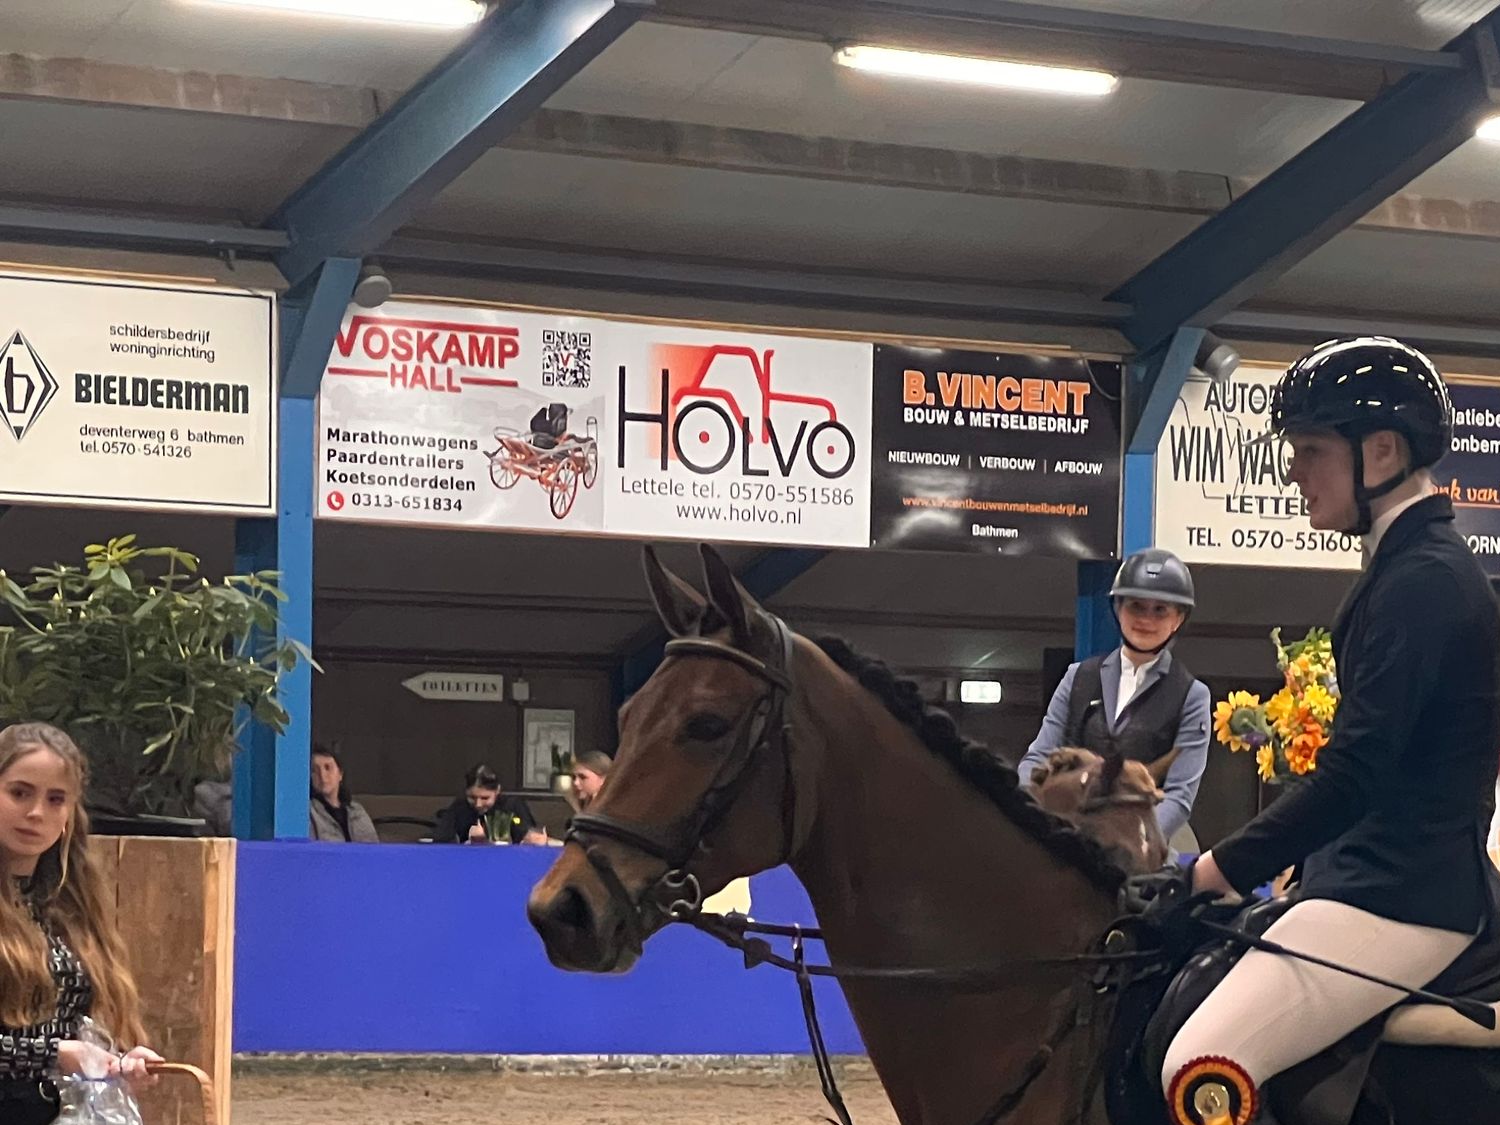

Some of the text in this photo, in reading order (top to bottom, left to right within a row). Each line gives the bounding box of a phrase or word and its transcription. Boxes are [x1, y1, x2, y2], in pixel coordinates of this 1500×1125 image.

[109, 324, 211, 343] schildersbedrijf
[336, 315, 520, 369] VOSKAMP
[109, 342, 215, 363] woninginrichting
[390, 363, 462, 393] HALL
[74, 373, 249, 414] BIELDERMAN
[903, 407, 1089, 434] BOUW & METSELBEDRIJF
[79, 424, 245, 445] deventerweg 6 bathmen
[326, 427, 479, 451] Marathonwagens
[80, 441, 99, 454] tel.
[1170, 425, 1296, 486] WIM WAG
[326, 449, 464, 470] Paardentrailers
[888, 451, 1103, 475] NIEUWBOUW VERBOUW AFBOUW
[326, 469, 476, 491] Koetsonderdelen
[621, 476, 854, 506] Lettele tel. 0570-551586
[1466, 488, 1499, 503] van
[351, 493, 463, 512] 0313-651834
[1226, 494, 1310, 517] LETTEL
[676, 504, 801, 525] www.holvo.nl
[972, 523, 1018, 539] Bathmen
[1186, 526, 1221, 547] TEL.
[1462, 535, 1500, 554] ORN
